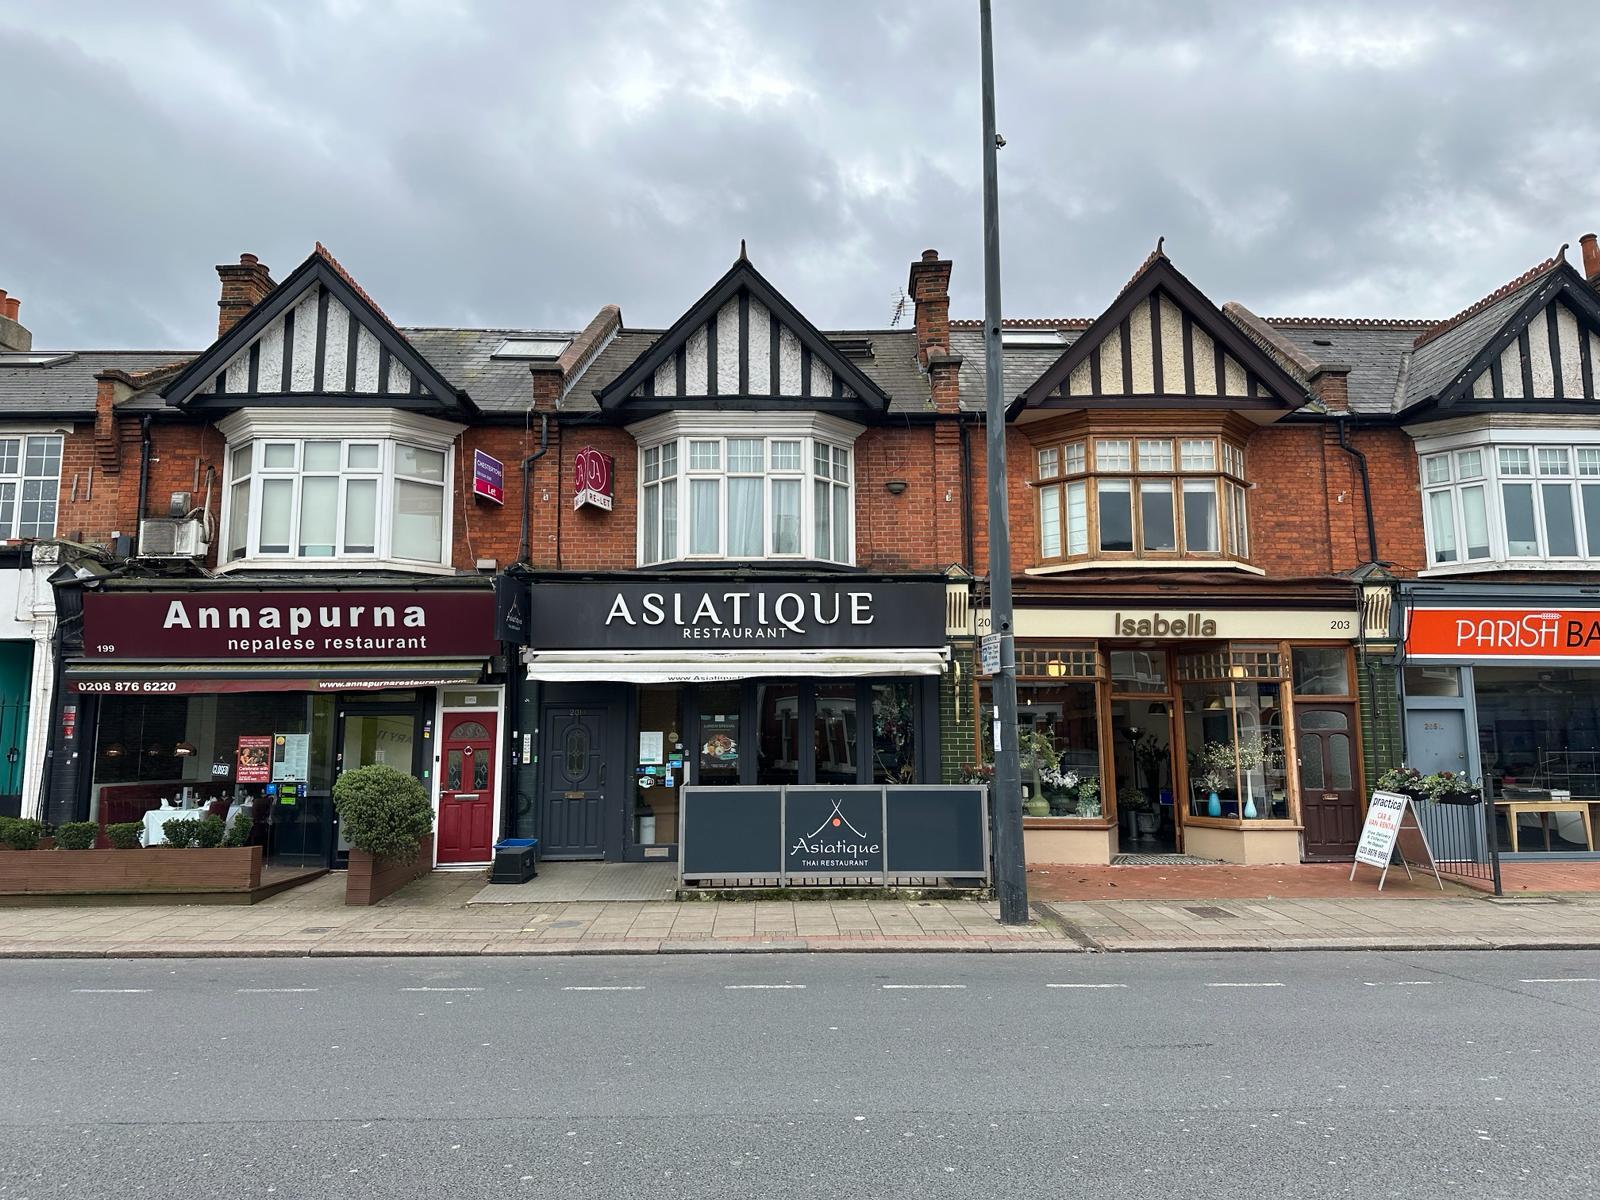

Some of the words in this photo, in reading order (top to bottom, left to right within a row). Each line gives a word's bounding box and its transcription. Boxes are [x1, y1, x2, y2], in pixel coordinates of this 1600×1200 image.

[487, 484, 497, 496] Let
[589, 492, 610, 507] RE-LET
[163, 600, 426, 635] Annapurna
[605, 592, 875, 633] ASIATIQUE
[978, 617, 991, 627] 20
[1115, 612, 1217, 637] Isabella
[1330, 620, 1350, 630] 203
[683, 627, 788, 639] RESTAURANT
[1456, 612, 1561, 648] PARISH
[97, 645, 115, 653] 199
[228, 636, 315, 653] nepalese
[324, 635, 427, 649] restaurant
[78, 682, 111, 691] 0208
[115, 682, 140, 691] 876
[143, 682, 177, 691] 6220
[790, 838, 880, 858] Asiatique
